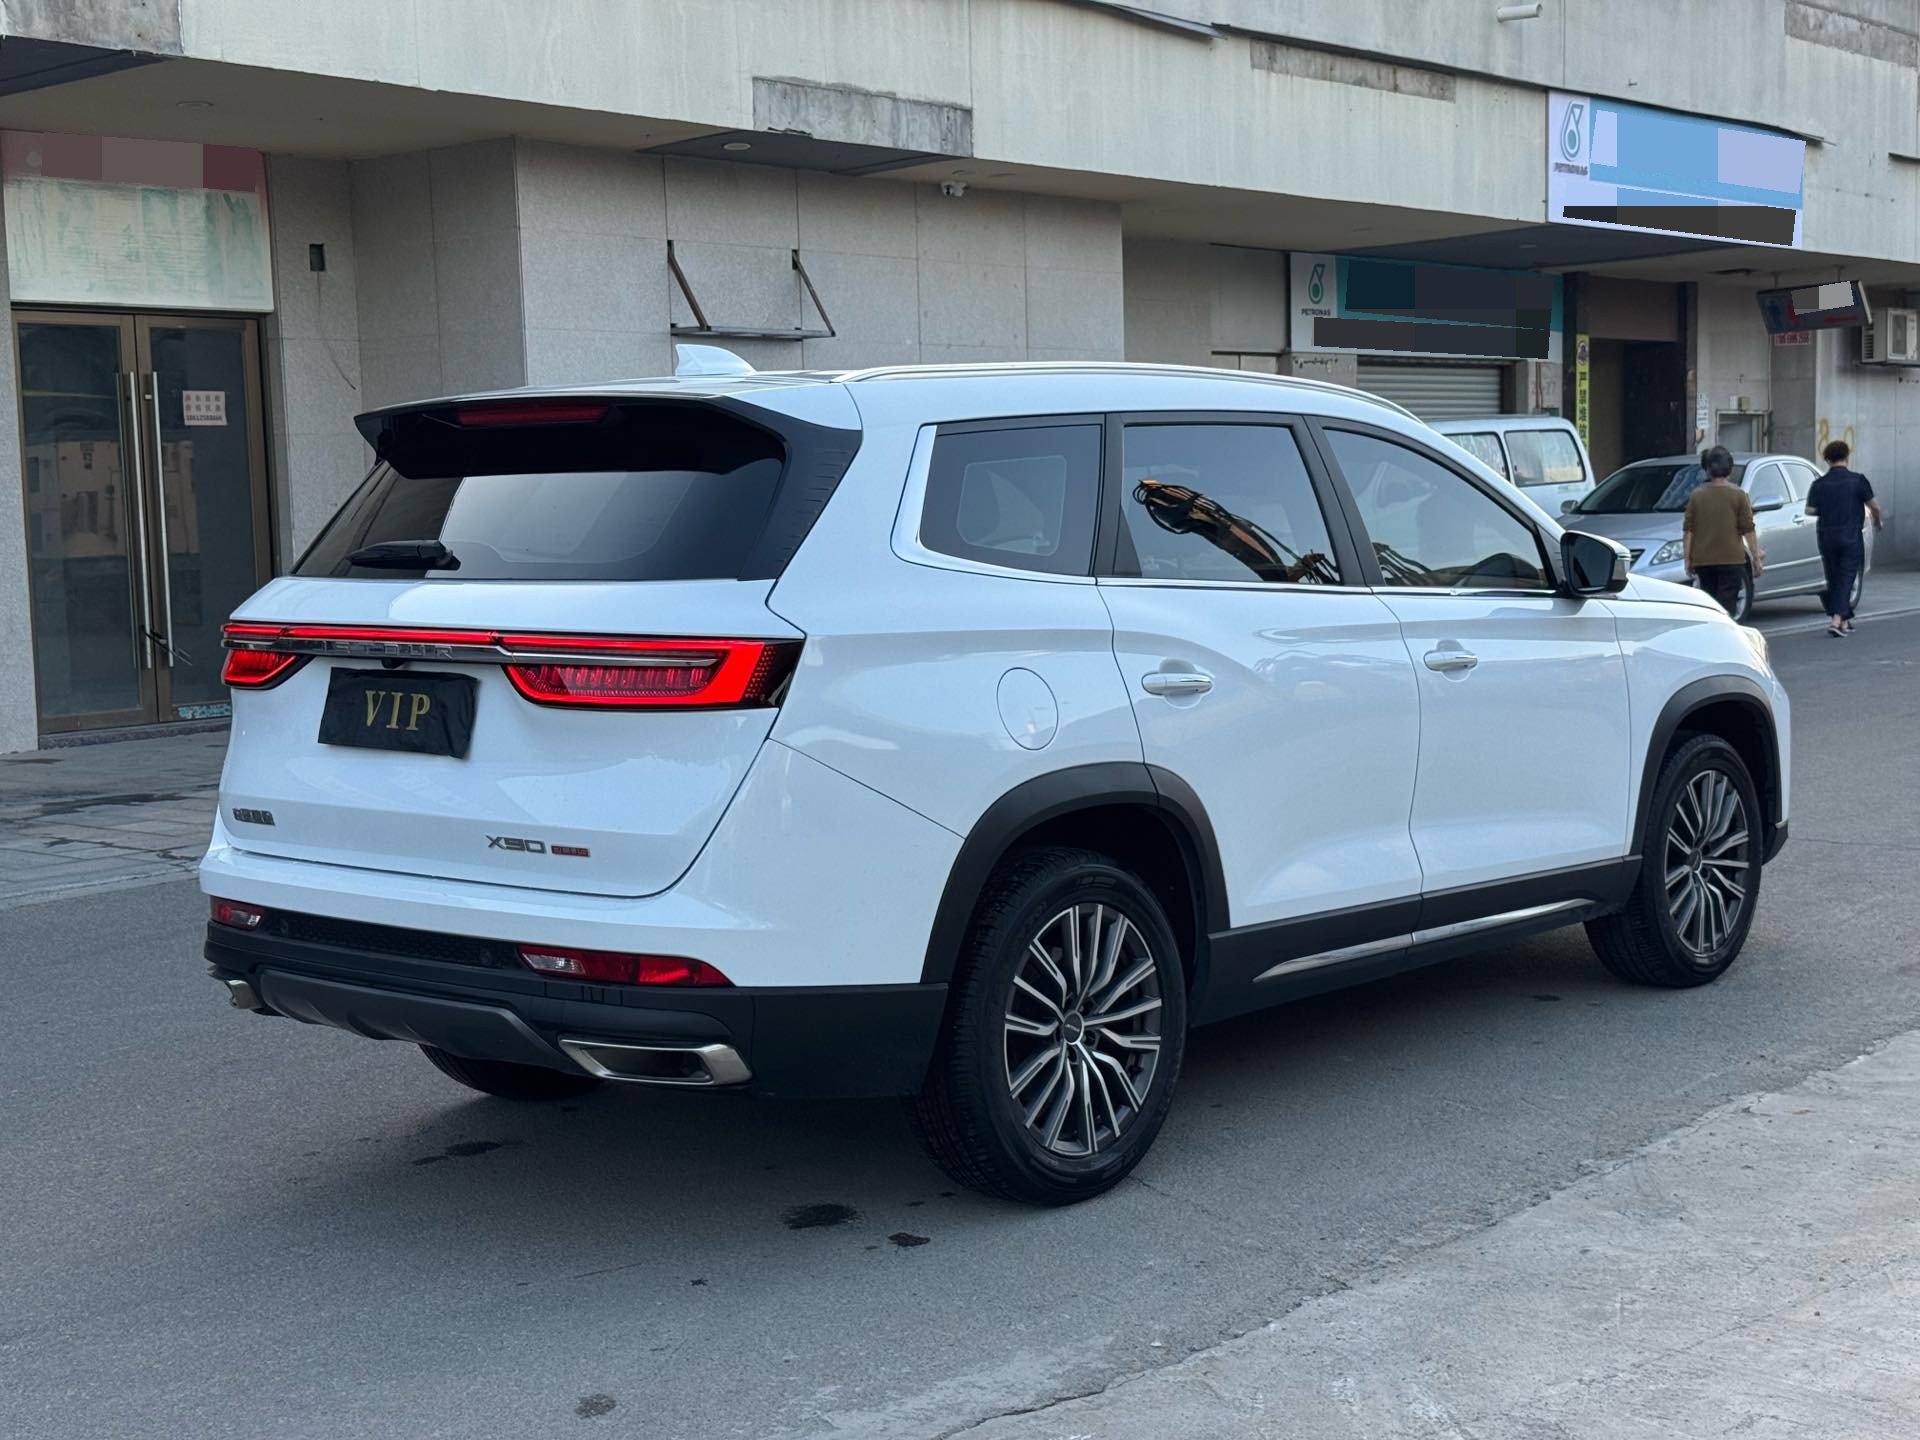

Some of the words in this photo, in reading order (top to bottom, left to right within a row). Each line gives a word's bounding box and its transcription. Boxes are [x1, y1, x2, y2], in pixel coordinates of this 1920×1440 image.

[1553, 161, 1588, 176] PETRONAS
[1300, 307, 1331, 317] PETRONAS
[365, 690, 431, 731] VIP
[485, 835, 547, 854] X90
